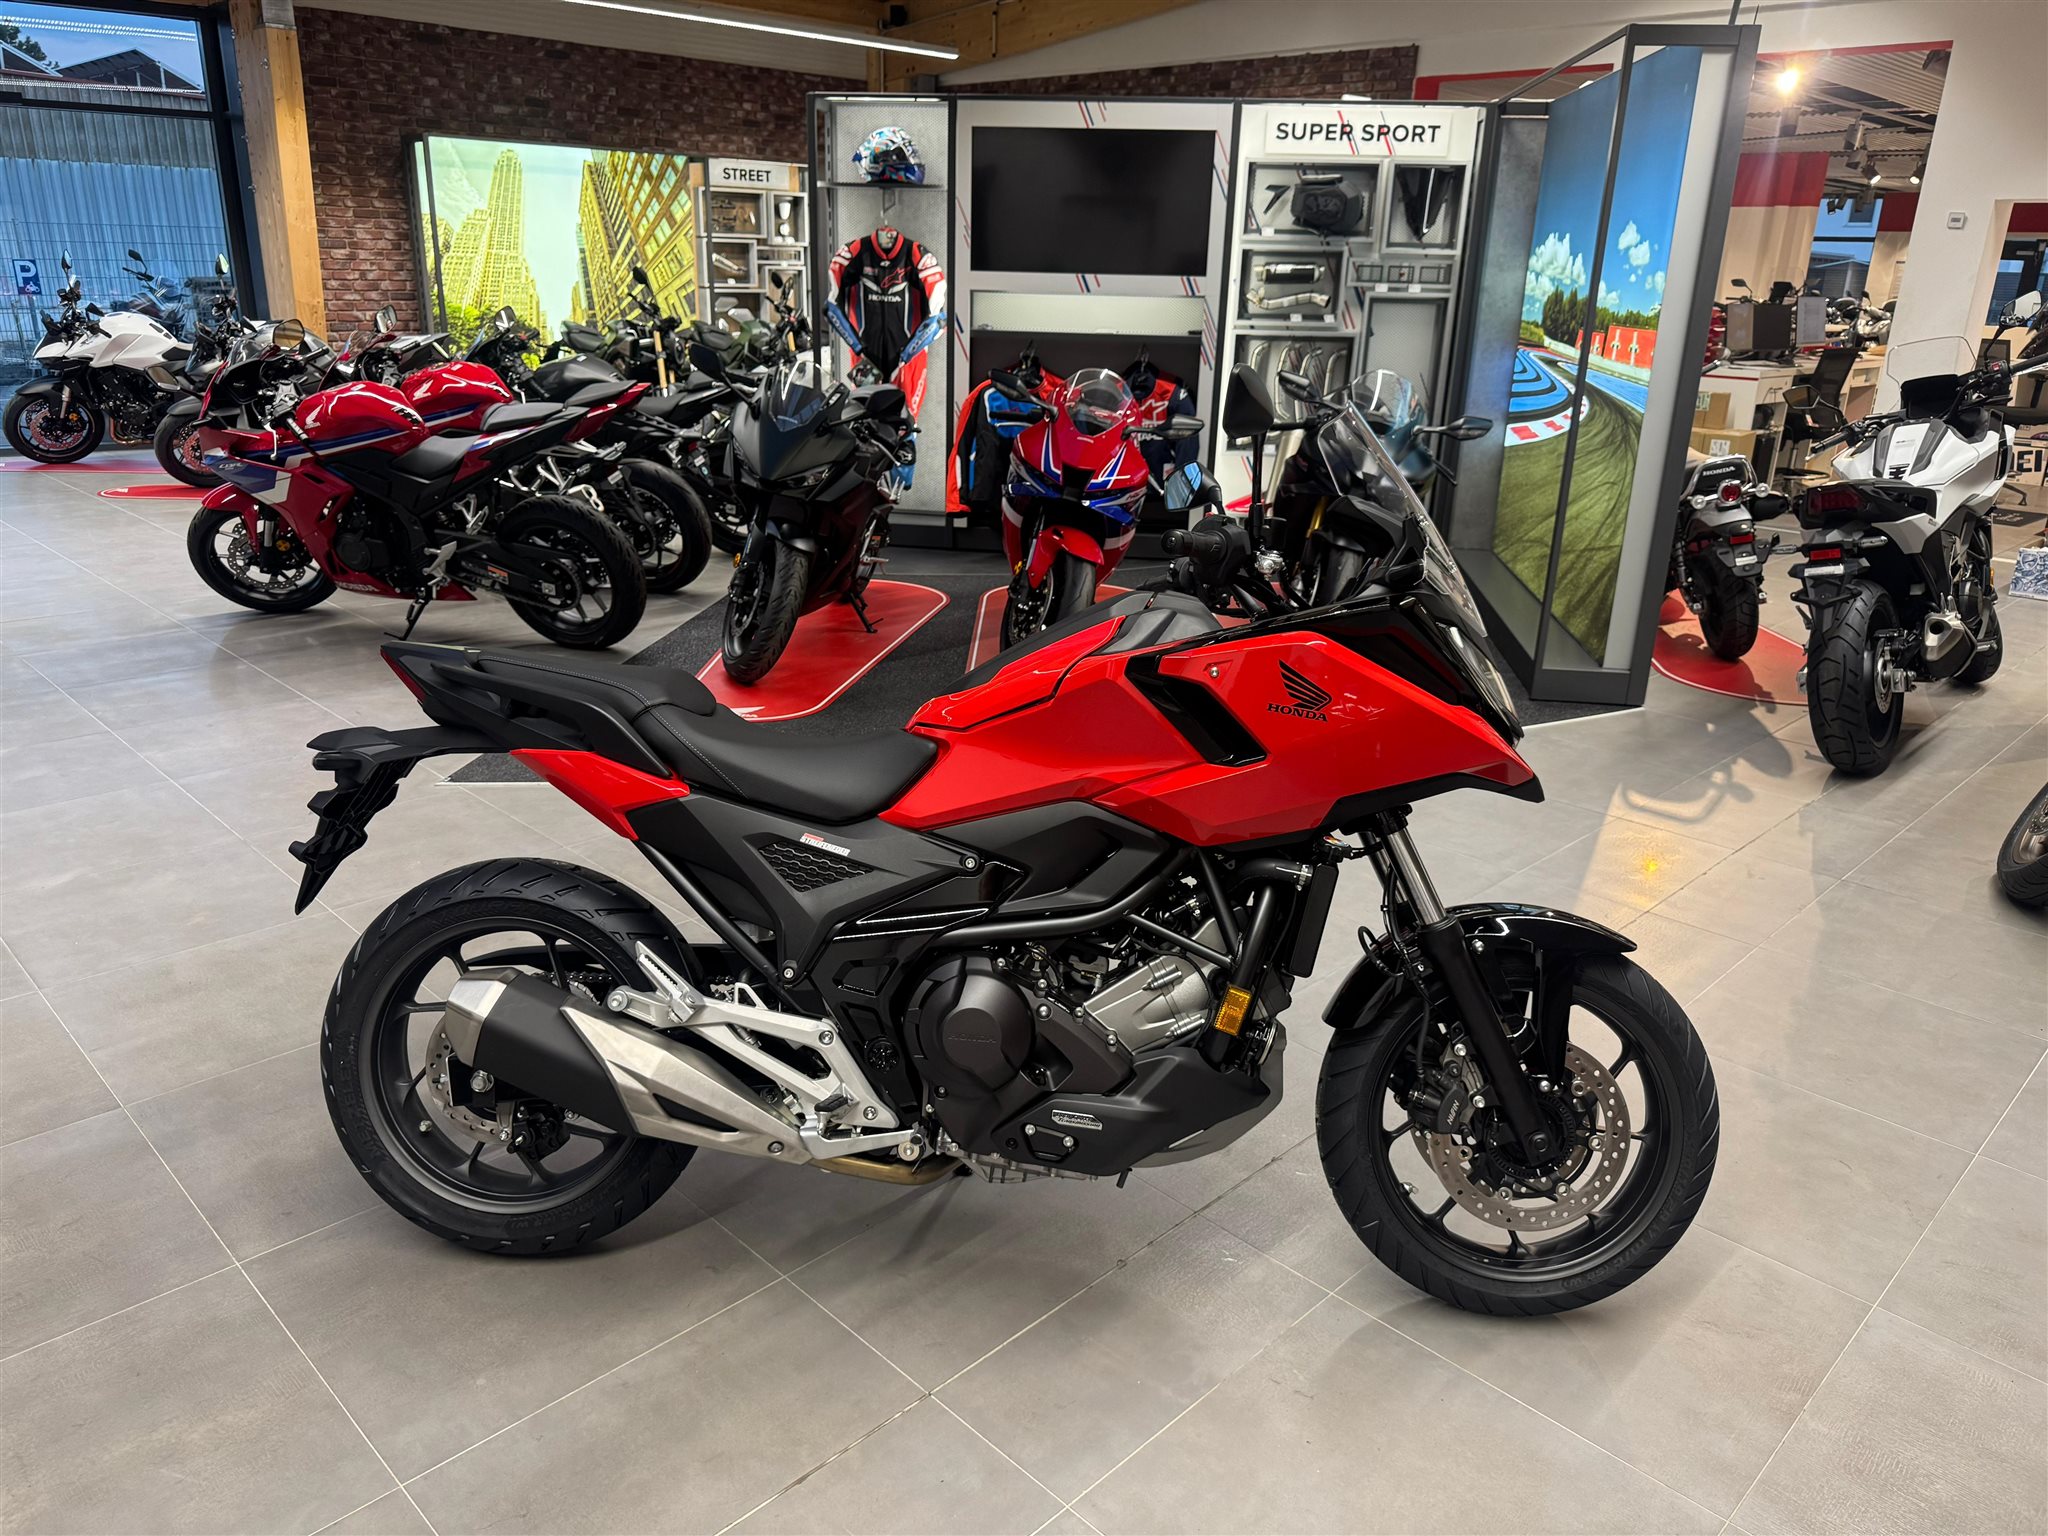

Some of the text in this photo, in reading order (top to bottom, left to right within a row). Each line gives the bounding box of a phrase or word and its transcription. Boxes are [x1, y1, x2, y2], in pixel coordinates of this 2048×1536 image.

[1276, 122, 1441, 143] SUPER SPORT
[723, 168, 771, 182] STREET
[13, 260, 37, 288] P
[868, 294, 902, 302] HONDA
[1702, 466, 1735, 476] HONDA
[1267, 703, 1328, 722] HONDA
